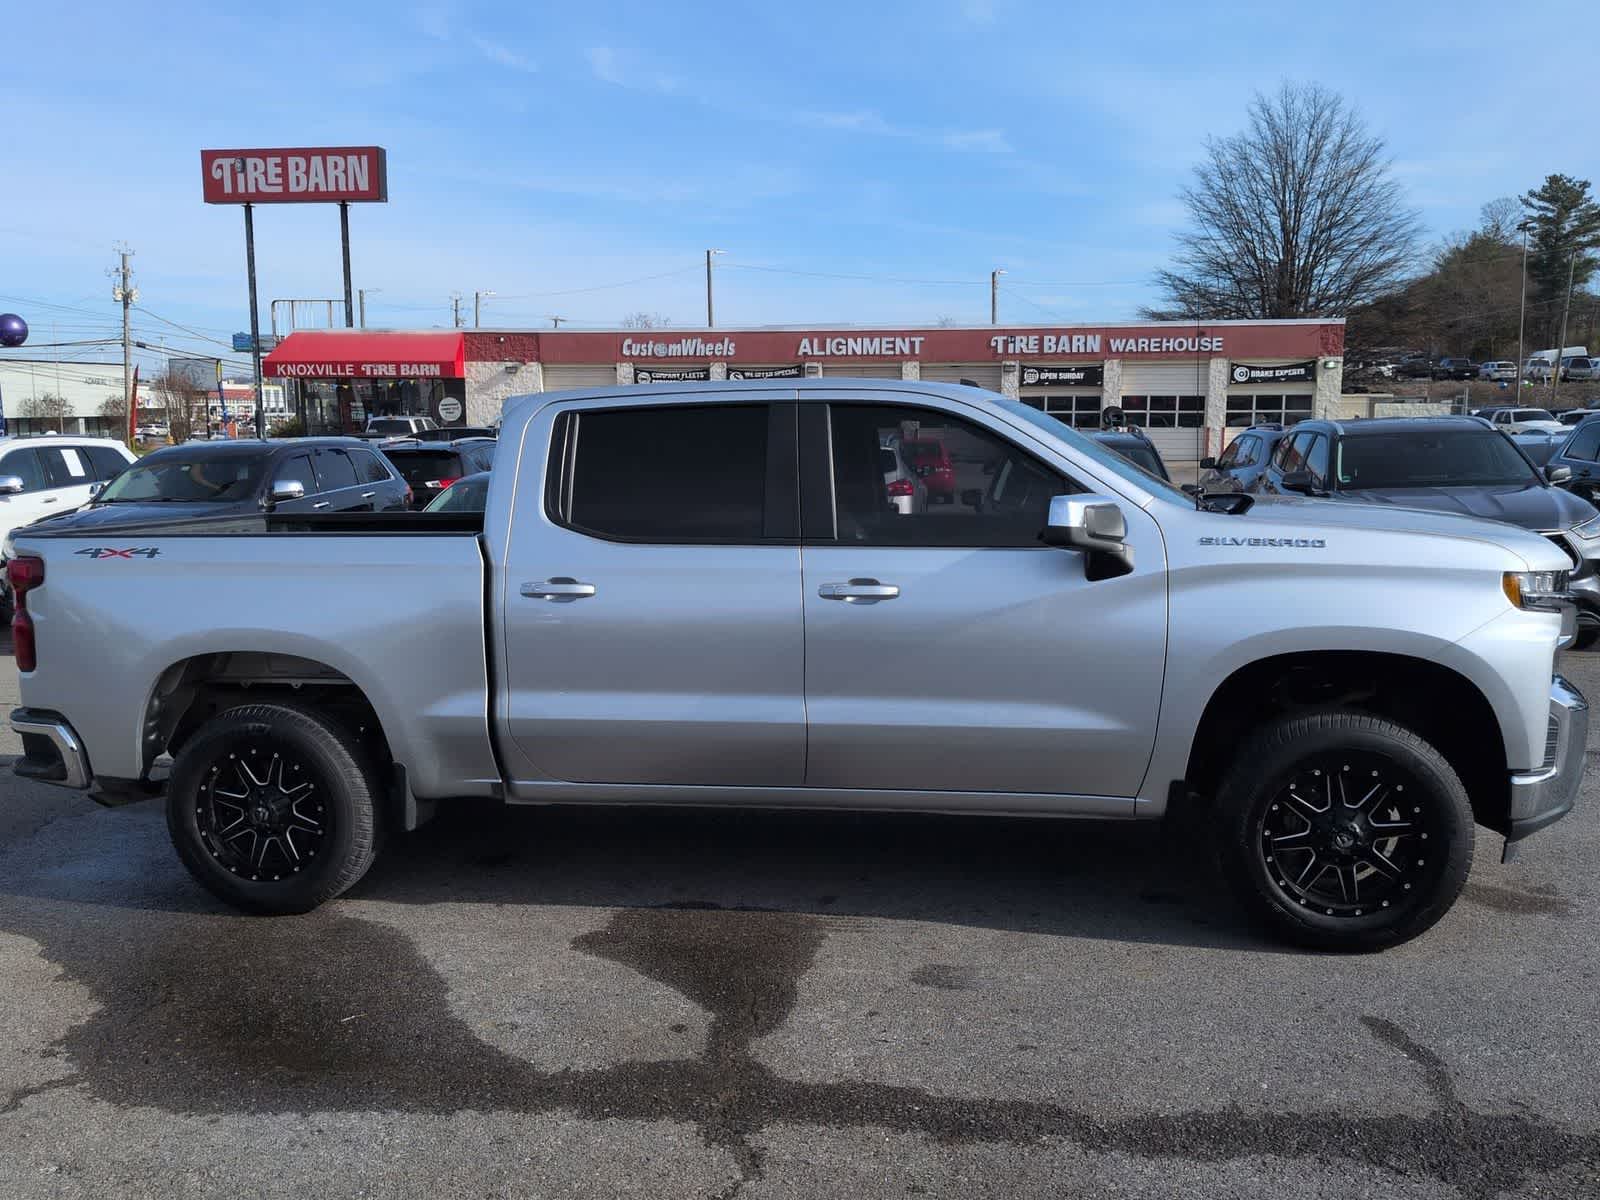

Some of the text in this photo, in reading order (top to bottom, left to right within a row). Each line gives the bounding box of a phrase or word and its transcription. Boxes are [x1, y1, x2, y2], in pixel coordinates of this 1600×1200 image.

[288, 154, 369, 192] BARN
[798, 337, 925, 356] ALIGNMENT
[1043, 335, 1101, 354] BARN
[1110, 337, 1224, 353] WAREHOUSE
[276, 364, 354, 376] KNOXVILLE
[400, 364, 440, 376] BARN
[1040, 372, 1085, 380] OPEN SUNDAY
[1250, 369, 1274, 378] BRAKE
[1199, 536, 1327, 548] SILVERADO
